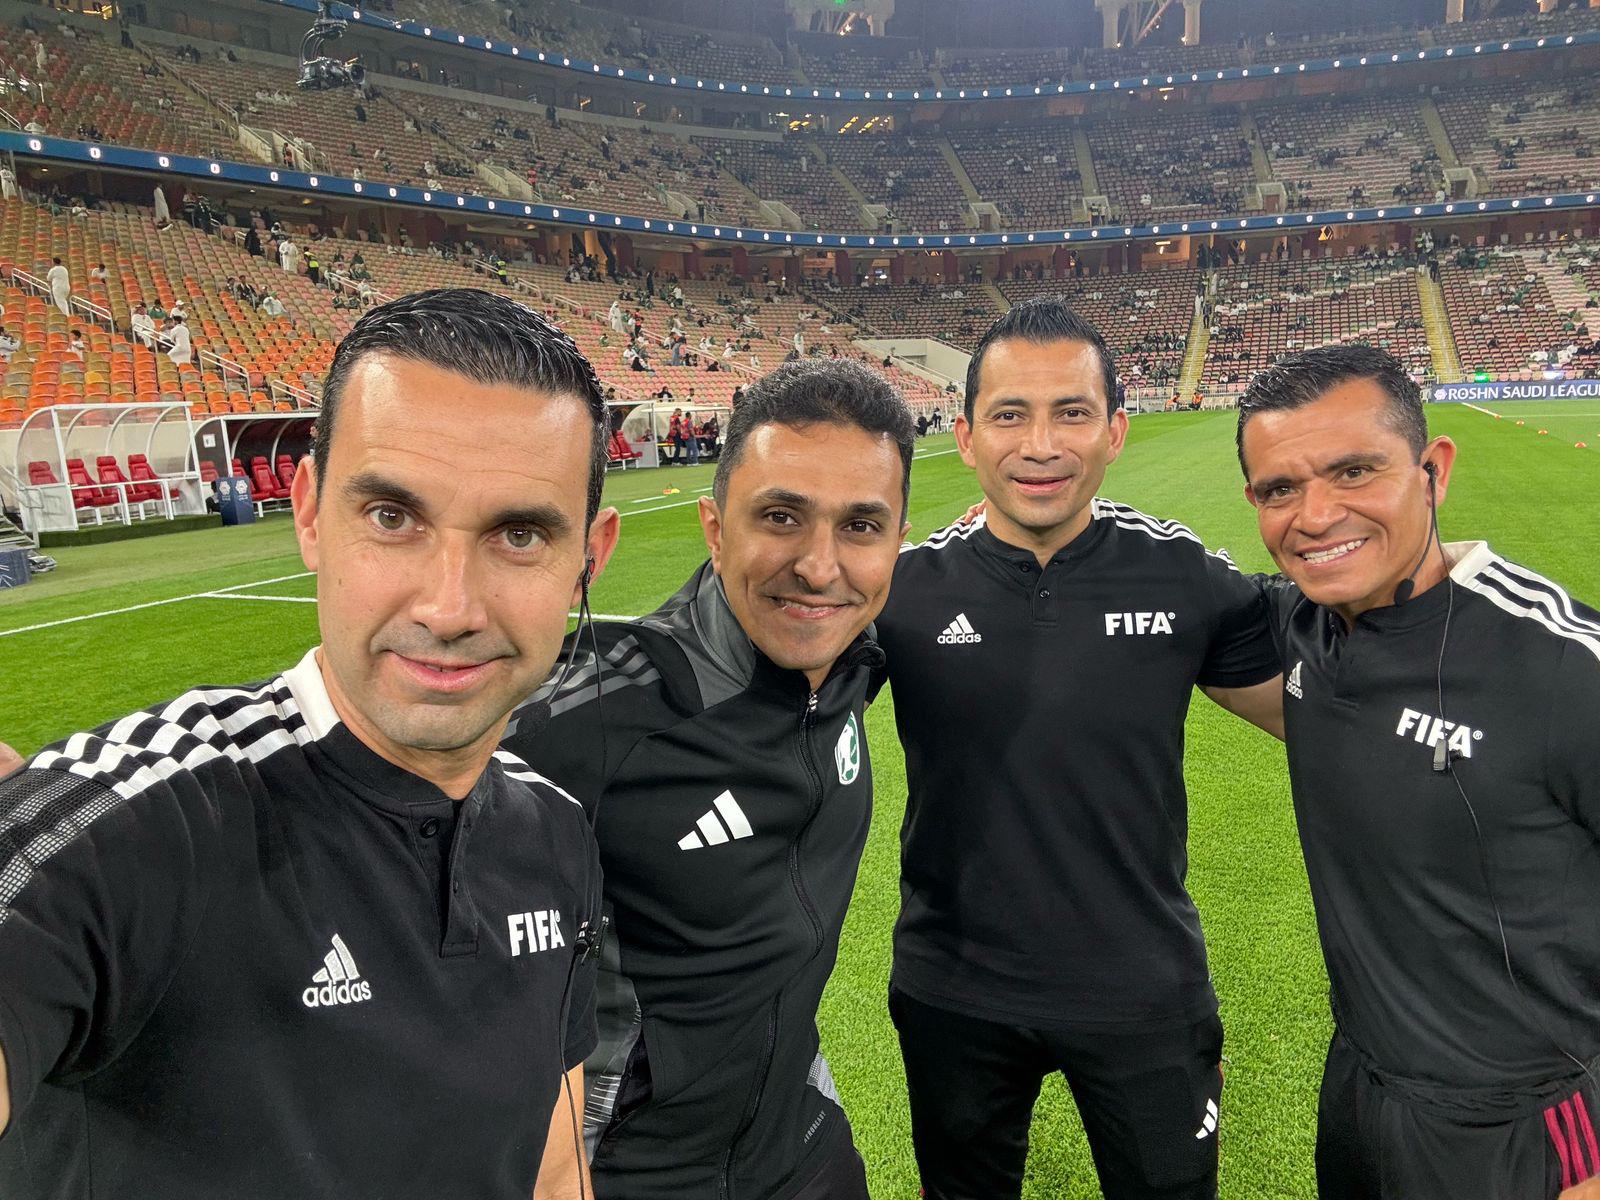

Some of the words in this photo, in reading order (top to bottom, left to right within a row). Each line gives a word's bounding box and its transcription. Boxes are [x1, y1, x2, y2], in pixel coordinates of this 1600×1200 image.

[1448, 387, 1499, 400] ROSHN
[1502, 385, 1546, 399] SAUDI
[1104, 611, 1174, 636] FIFA
[937, 632, 982, 645] adidas
[507, 909, 566, 957] FIFA
[302, 980, 372, 1008] adidas
